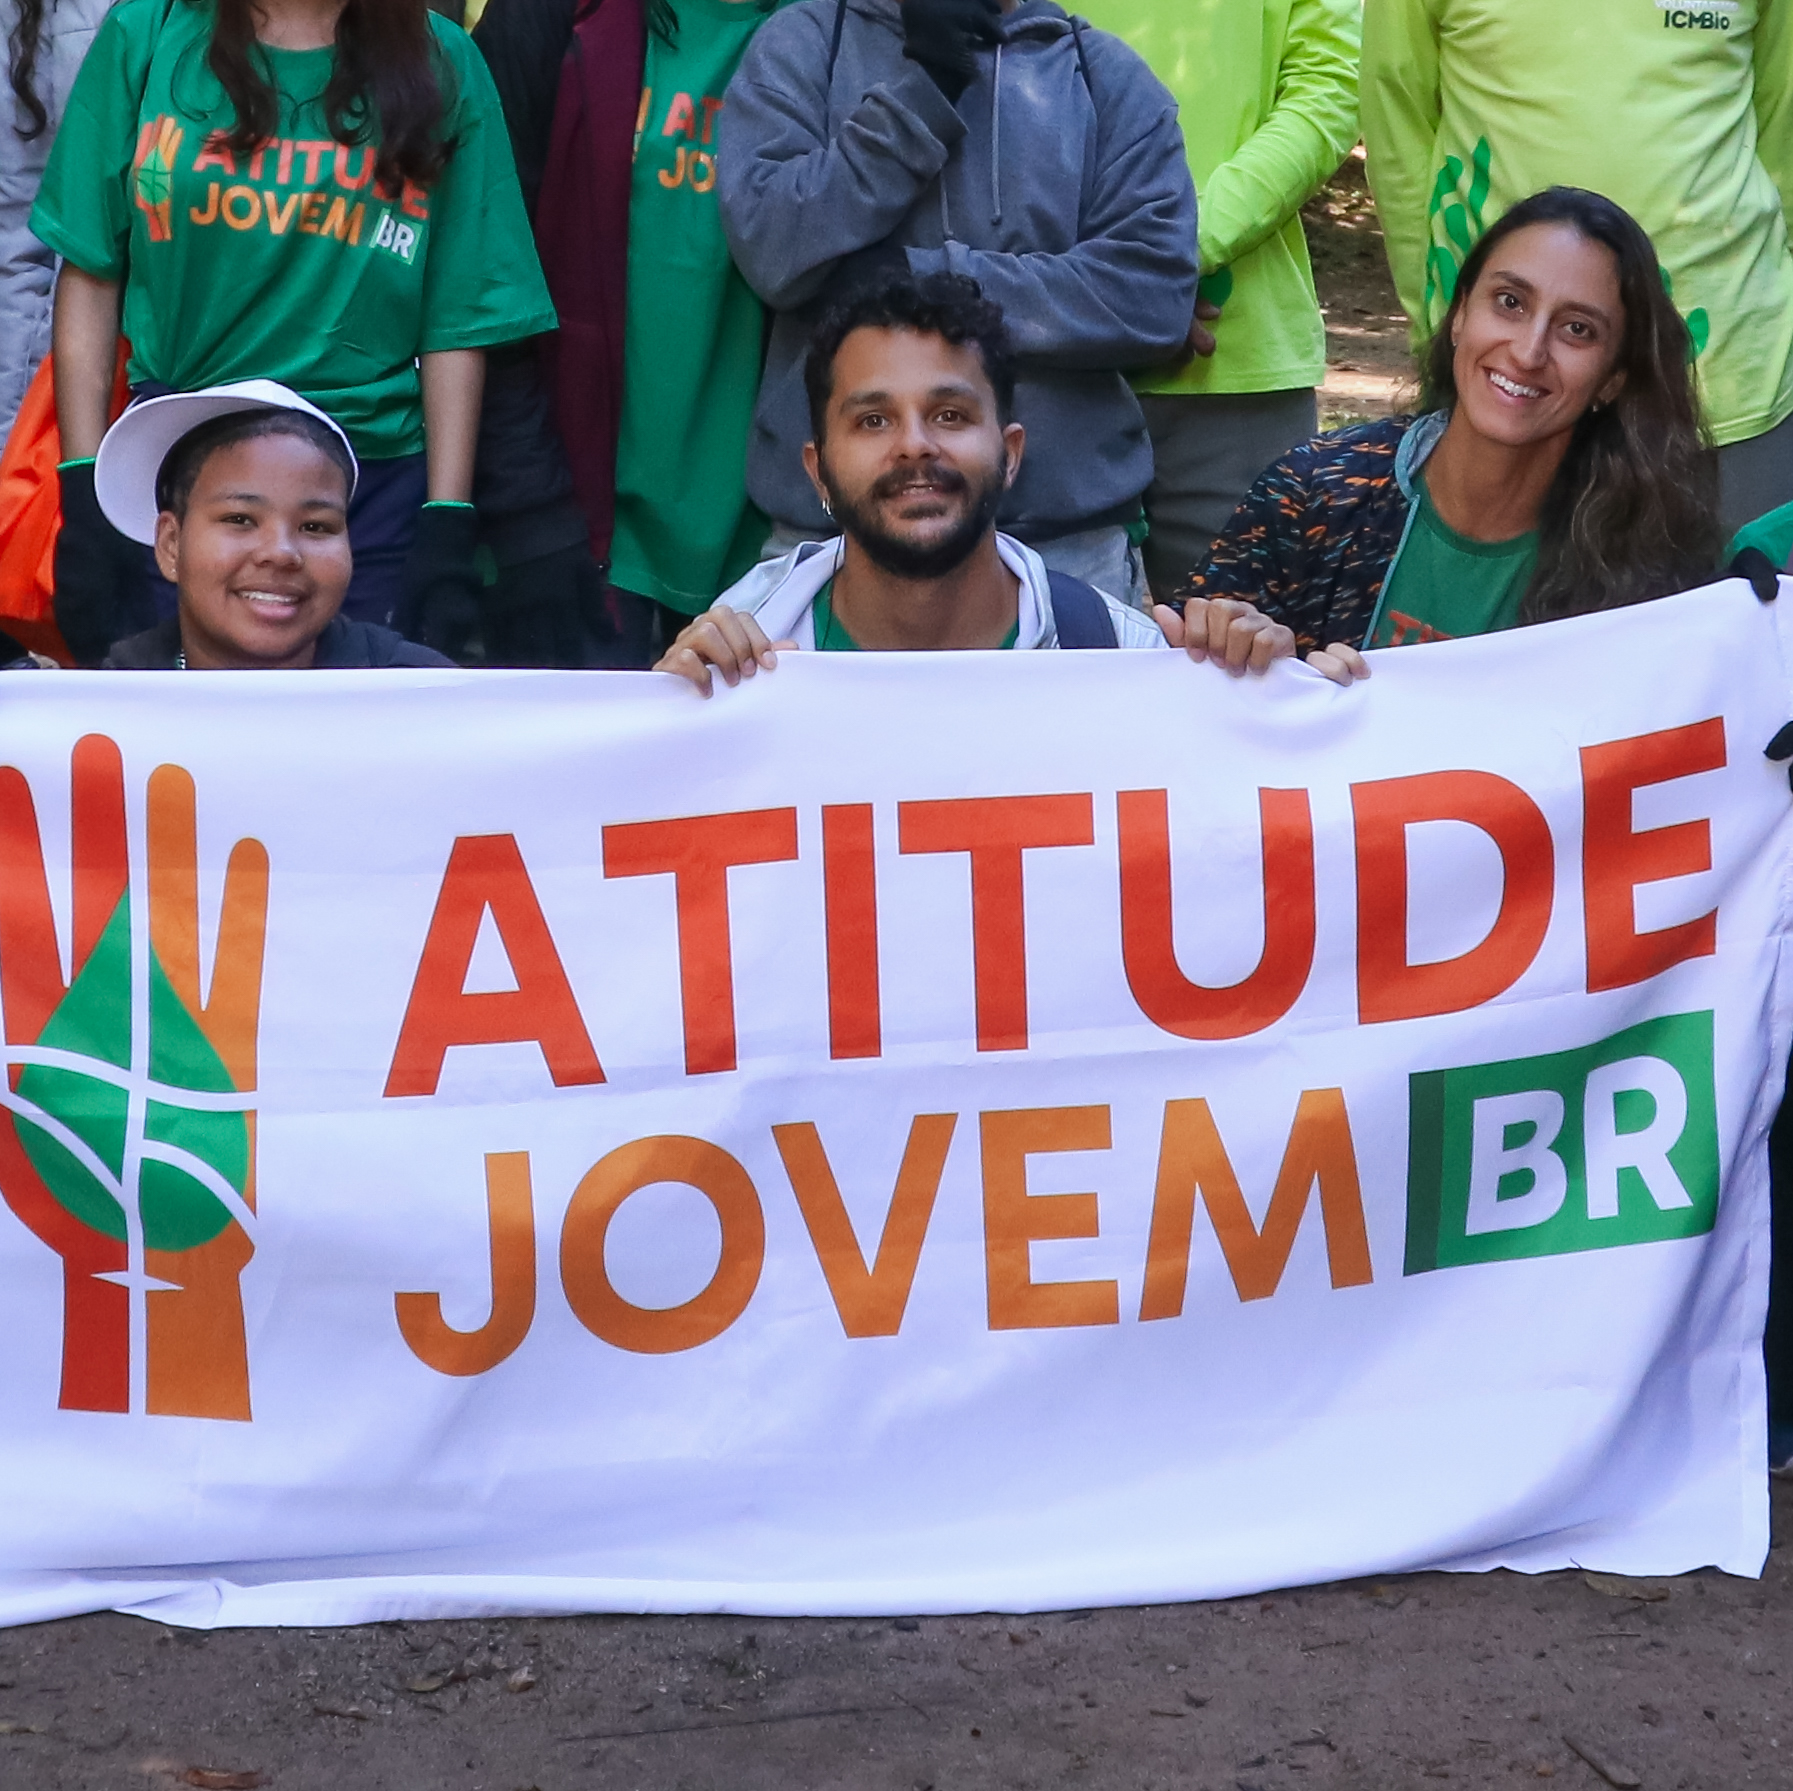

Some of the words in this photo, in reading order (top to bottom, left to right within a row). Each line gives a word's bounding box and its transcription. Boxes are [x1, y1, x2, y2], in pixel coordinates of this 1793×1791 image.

[1654, 0, 1740, 12] VOLUNTARIADO
[1664, 11, 1730, 30] ICMBio
[192, 129, 429, 220] ATITUE
[190, 182, 366, 247] JOVEM
[376, 214, 415, 258] BR
[382, 715, 1728, 1098] ATITUDE
[394, 1086, 1376, 1377] JOVEM
[1465, 1056, 1694, 1236] BR
